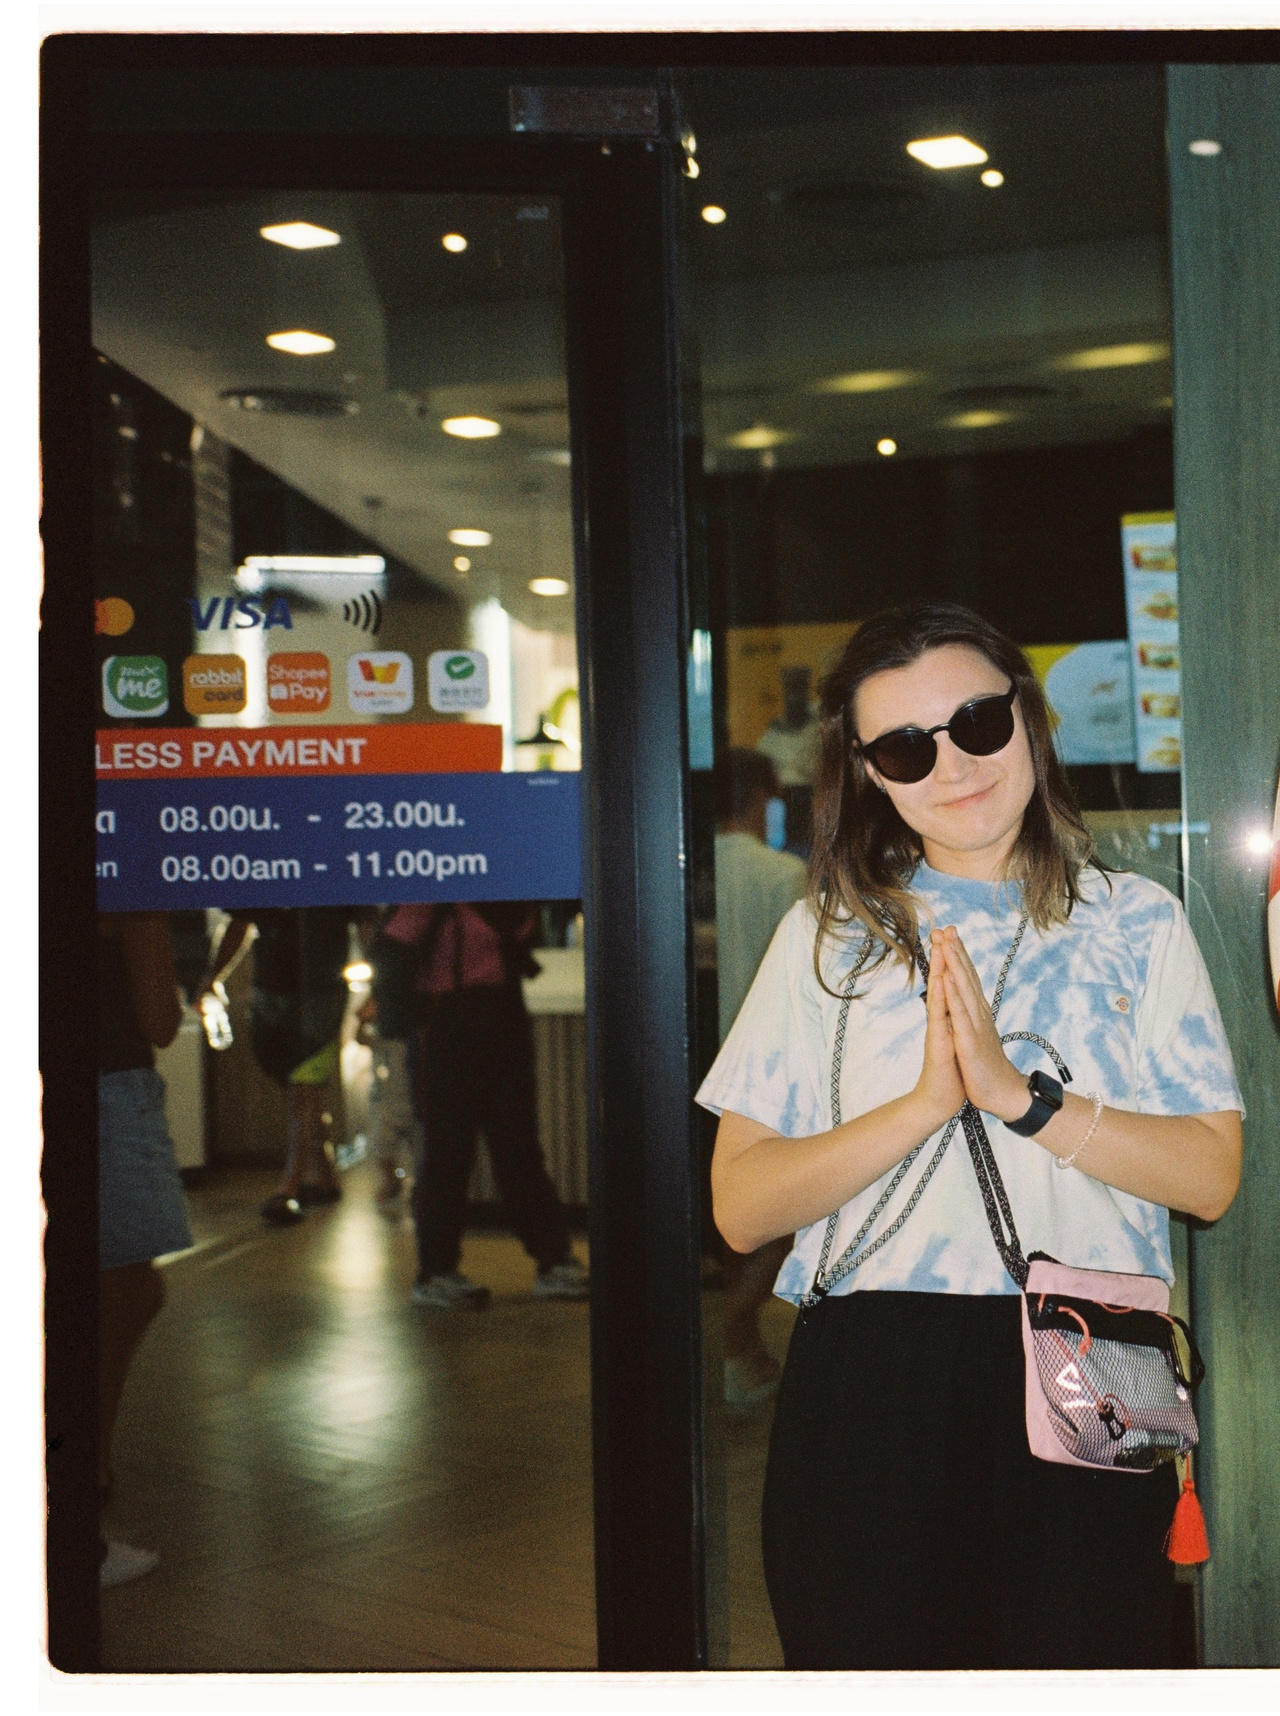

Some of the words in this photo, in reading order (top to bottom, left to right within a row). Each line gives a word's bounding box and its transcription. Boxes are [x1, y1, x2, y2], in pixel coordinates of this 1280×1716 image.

[188, 595, 294, 631] VISA
[190, 669, 243, 684] rabbit
[269, 664, 328, 681] Shopee
[117, 677, 163, 700] me
[204, 689, 244, 702] card
[290, 683, 328, 704] Pay
[96, 741, 183, 770] LESS
[192, 738, 368, 768] PAYMENT
[161, 854, 301, 882] 08.00am
[346, 849, 488, 882] 11.00pm
